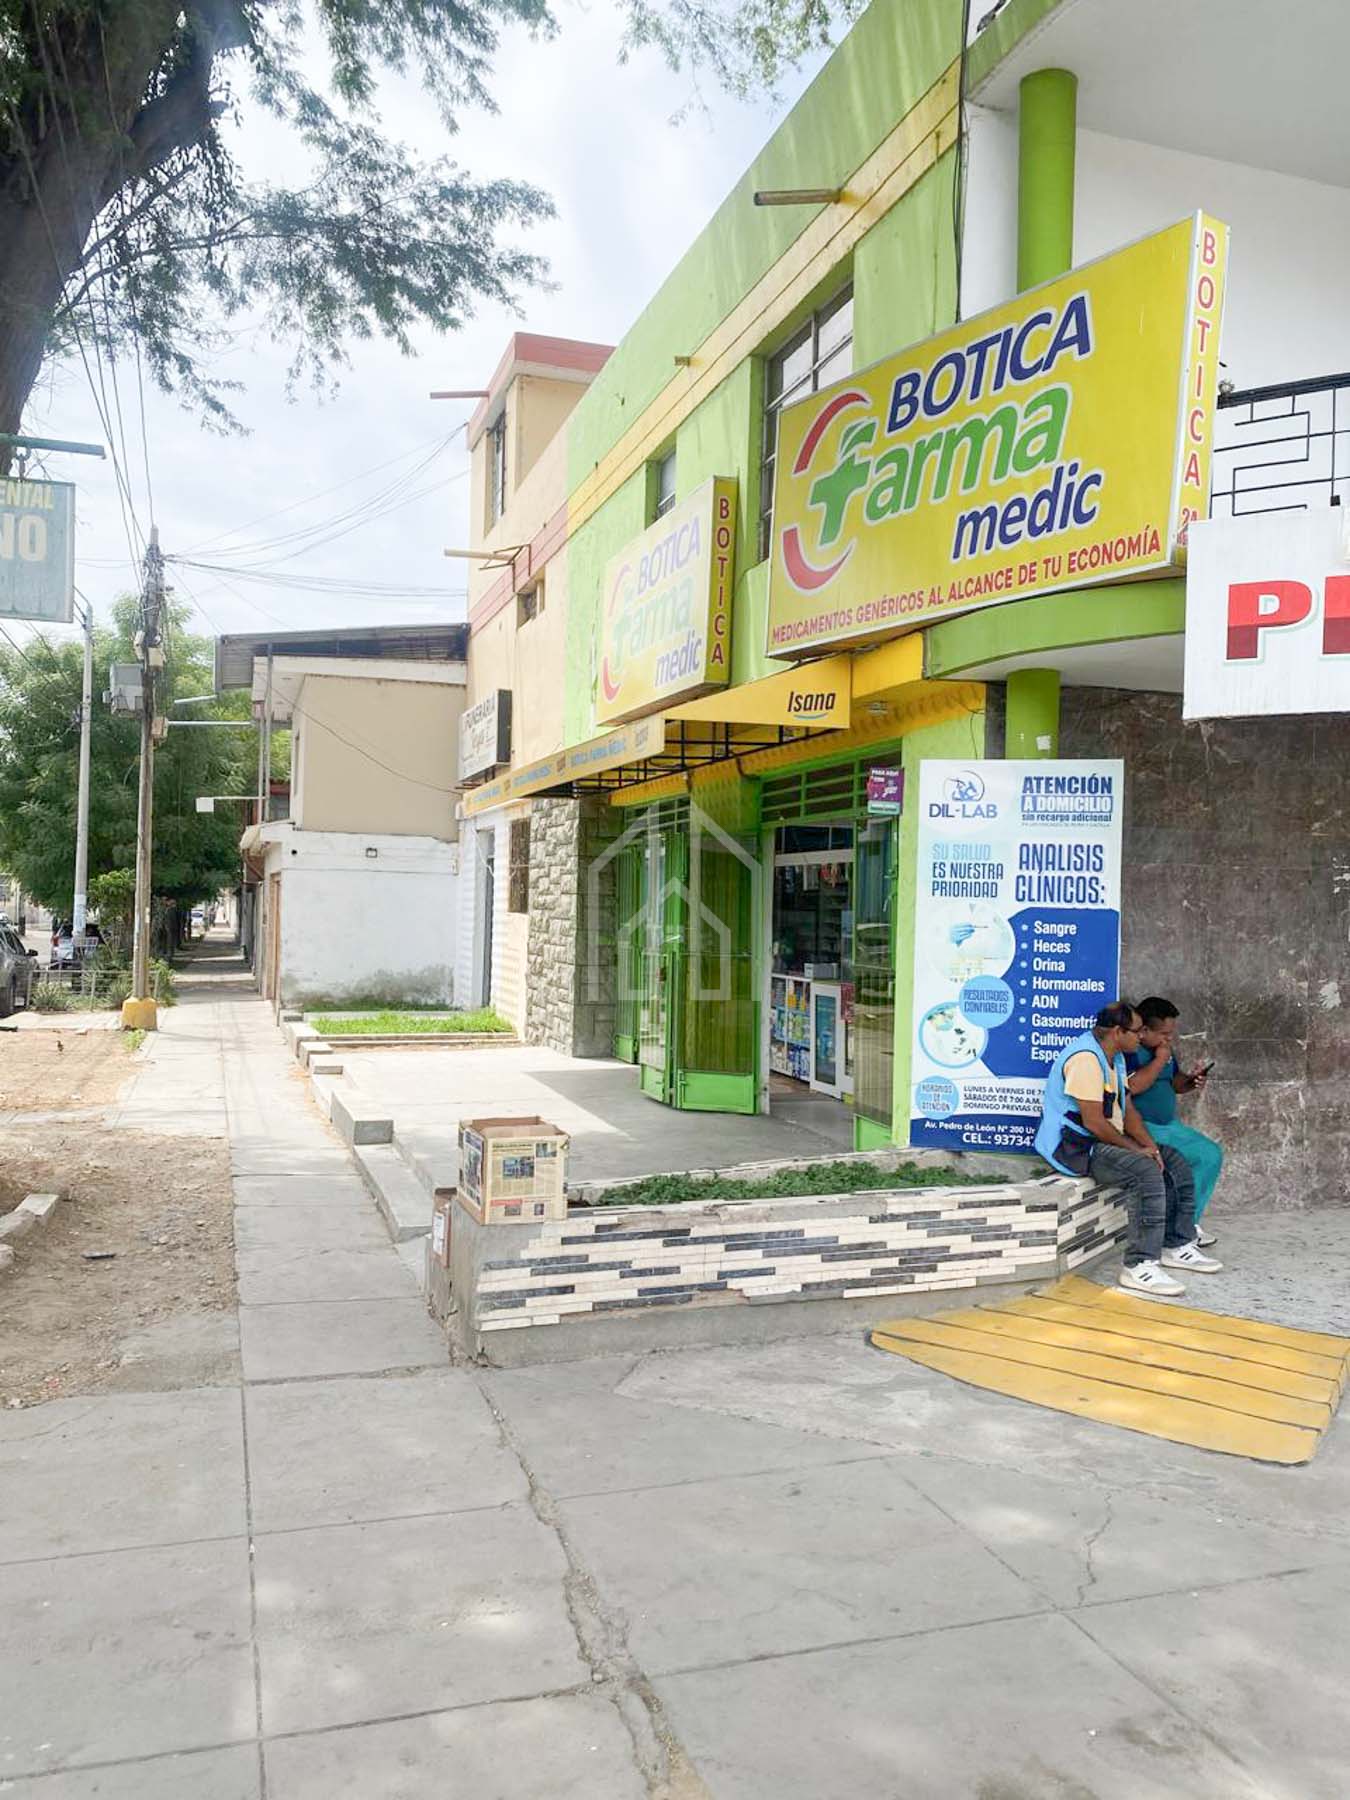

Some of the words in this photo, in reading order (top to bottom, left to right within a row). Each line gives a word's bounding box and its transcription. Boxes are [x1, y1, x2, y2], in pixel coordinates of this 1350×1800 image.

[888, 296, 1091, 433] BOTICA
[1184, 230, 1216, 487] BOTICA
[952, 462, 1101, 559] medic
[637, 516, 700, 595] BOTICA
[711, 498, 730, 665] BOTICA
[771, 608, 853, 645] MEDICAMENTOS
[856, 591, 924, 624] GENÉRICOS
[928, 590, 945, 609] AL
[948, 566, 1013, 601] ALCANCE
[1018, 564, 1037, 584] DE
[1042, 557, 1062, 578] TU
[1067, 526, 1161, 574] ECONOMÍA
[655, 630, 702, 687] medic
[787, 691, 836, 713] Isana
[1022, 773, 1112, 794] ATENCIÓN
[929, 803, 997, 818] DIL-LAB
[1023, 796, 1034, 812] A
[1036, 796, 1112, 812] DOMICILIO
[1022, 813, 1035, 821] sin
[1071, 813, 1112, 822] adicional
[932, 842, 949, 860] SU
[952, 843, 992, 861] SALUD
[932, 861, 946, 879] ES
[949, 861, 1004, 880] NUESTRA
[931, 880, 998, 898] PRIORIDAD
[1033, 920, 1077, 937] Sangre
[1033, 939, 1071, 953] Heces
[1033, 957, 1065, 972] Orina
[1032, 977, 1105, 992] Hormonales
[1032, 995, 1059, 1009] ADN
[995, 1087, 1025, 1095] VIERNES
[998, 1095, 1009, 1103] DE
[963, 1102, 1001, 1110] DOMINGO
[938, 1121, 963, 1130] Pedro
[963, 1122, 975, 1131] de
[975, 1123, 996, 1132] León
